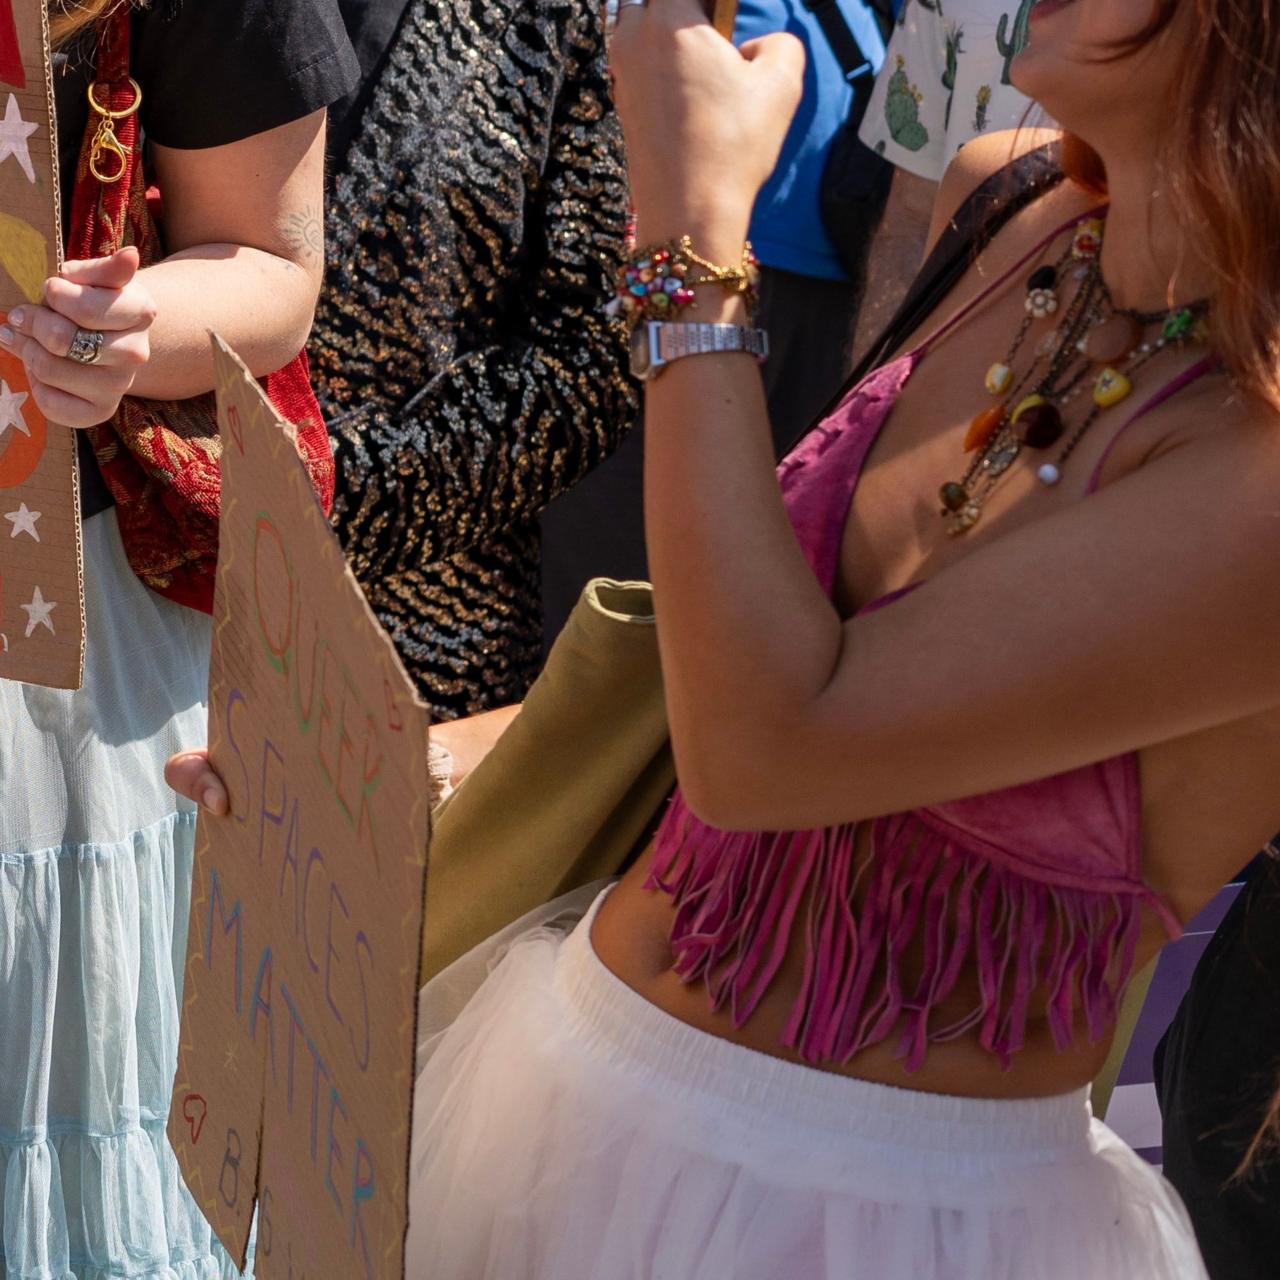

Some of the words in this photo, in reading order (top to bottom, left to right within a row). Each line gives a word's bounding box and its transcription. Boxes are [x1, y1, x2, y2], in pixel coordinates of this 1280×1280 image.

[225, 687, 375, 1073] SPACES
[254, 511, 385, 880] QUEER
[205, 865, 377, 1280] MATTER
